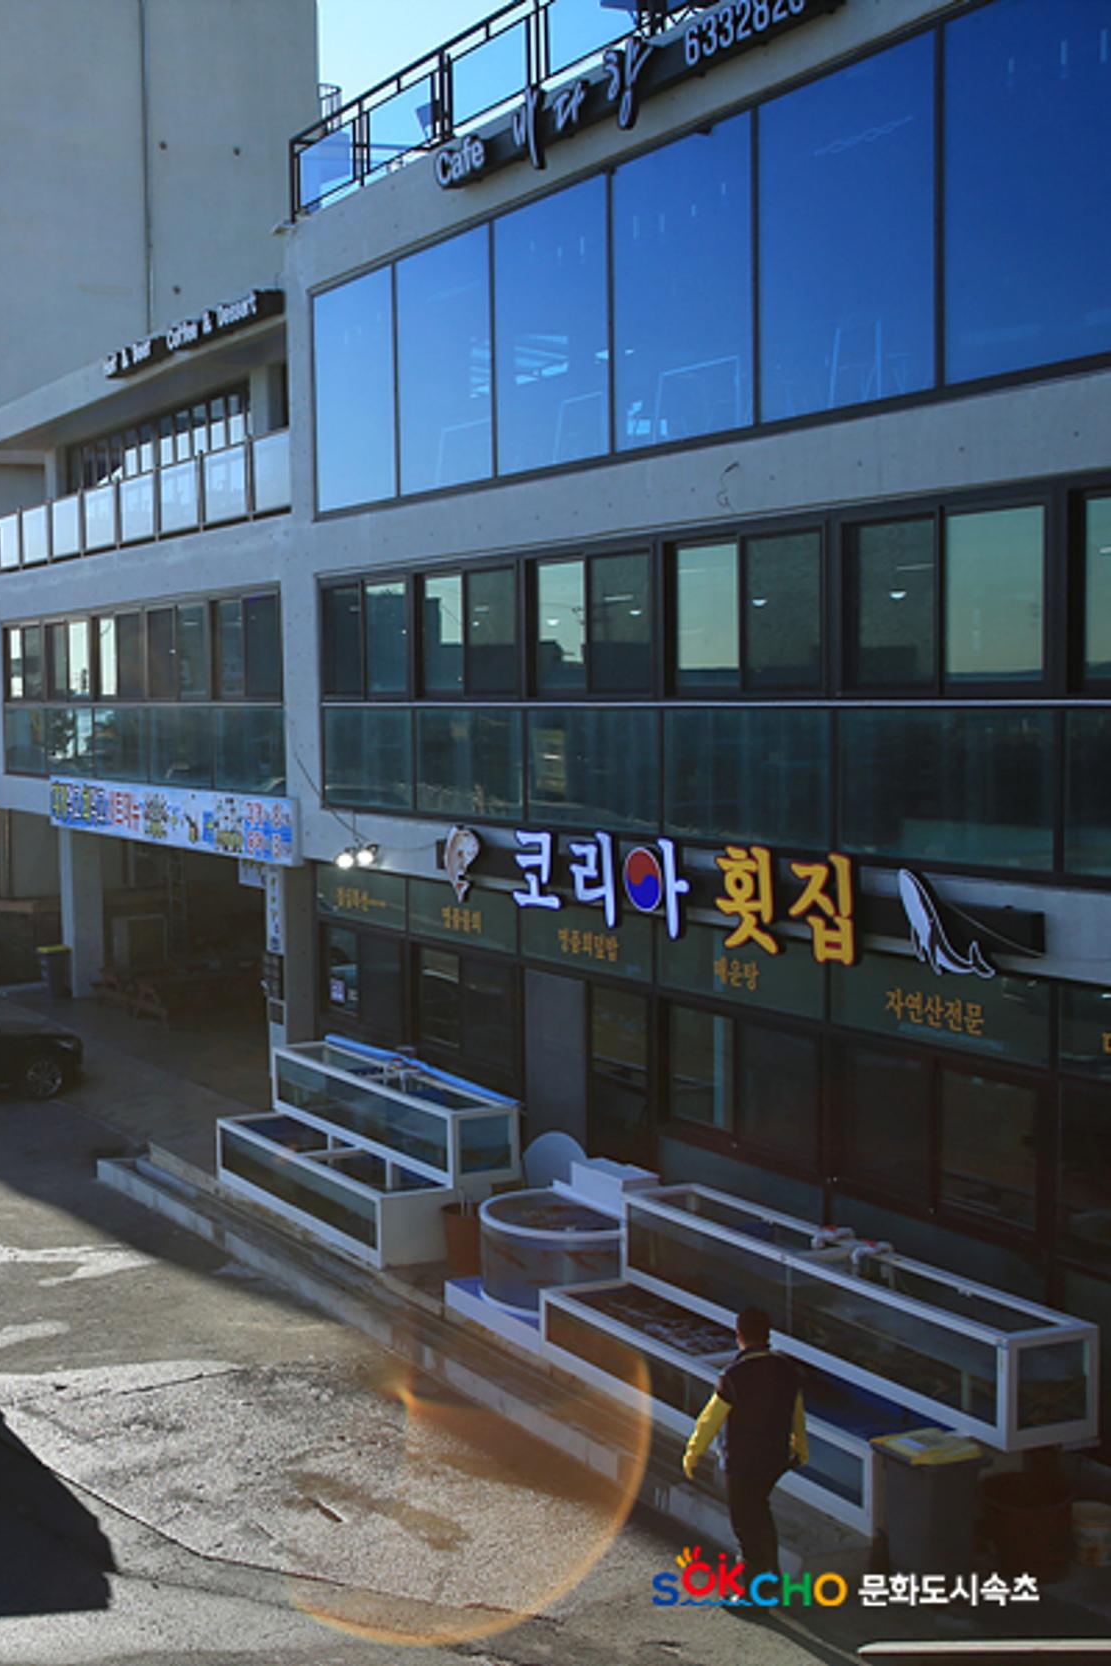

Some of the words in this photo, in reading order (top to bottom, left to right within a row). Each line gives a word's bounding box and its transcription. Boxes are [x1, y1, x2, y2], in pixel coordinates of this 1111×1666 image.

[435, 136, 484, 186] Cafe
[512, 829, 690, 940] 코리아
[715, 846, 856, 966] 횟집
[883, 987, 986, 1037] 자연산전문
